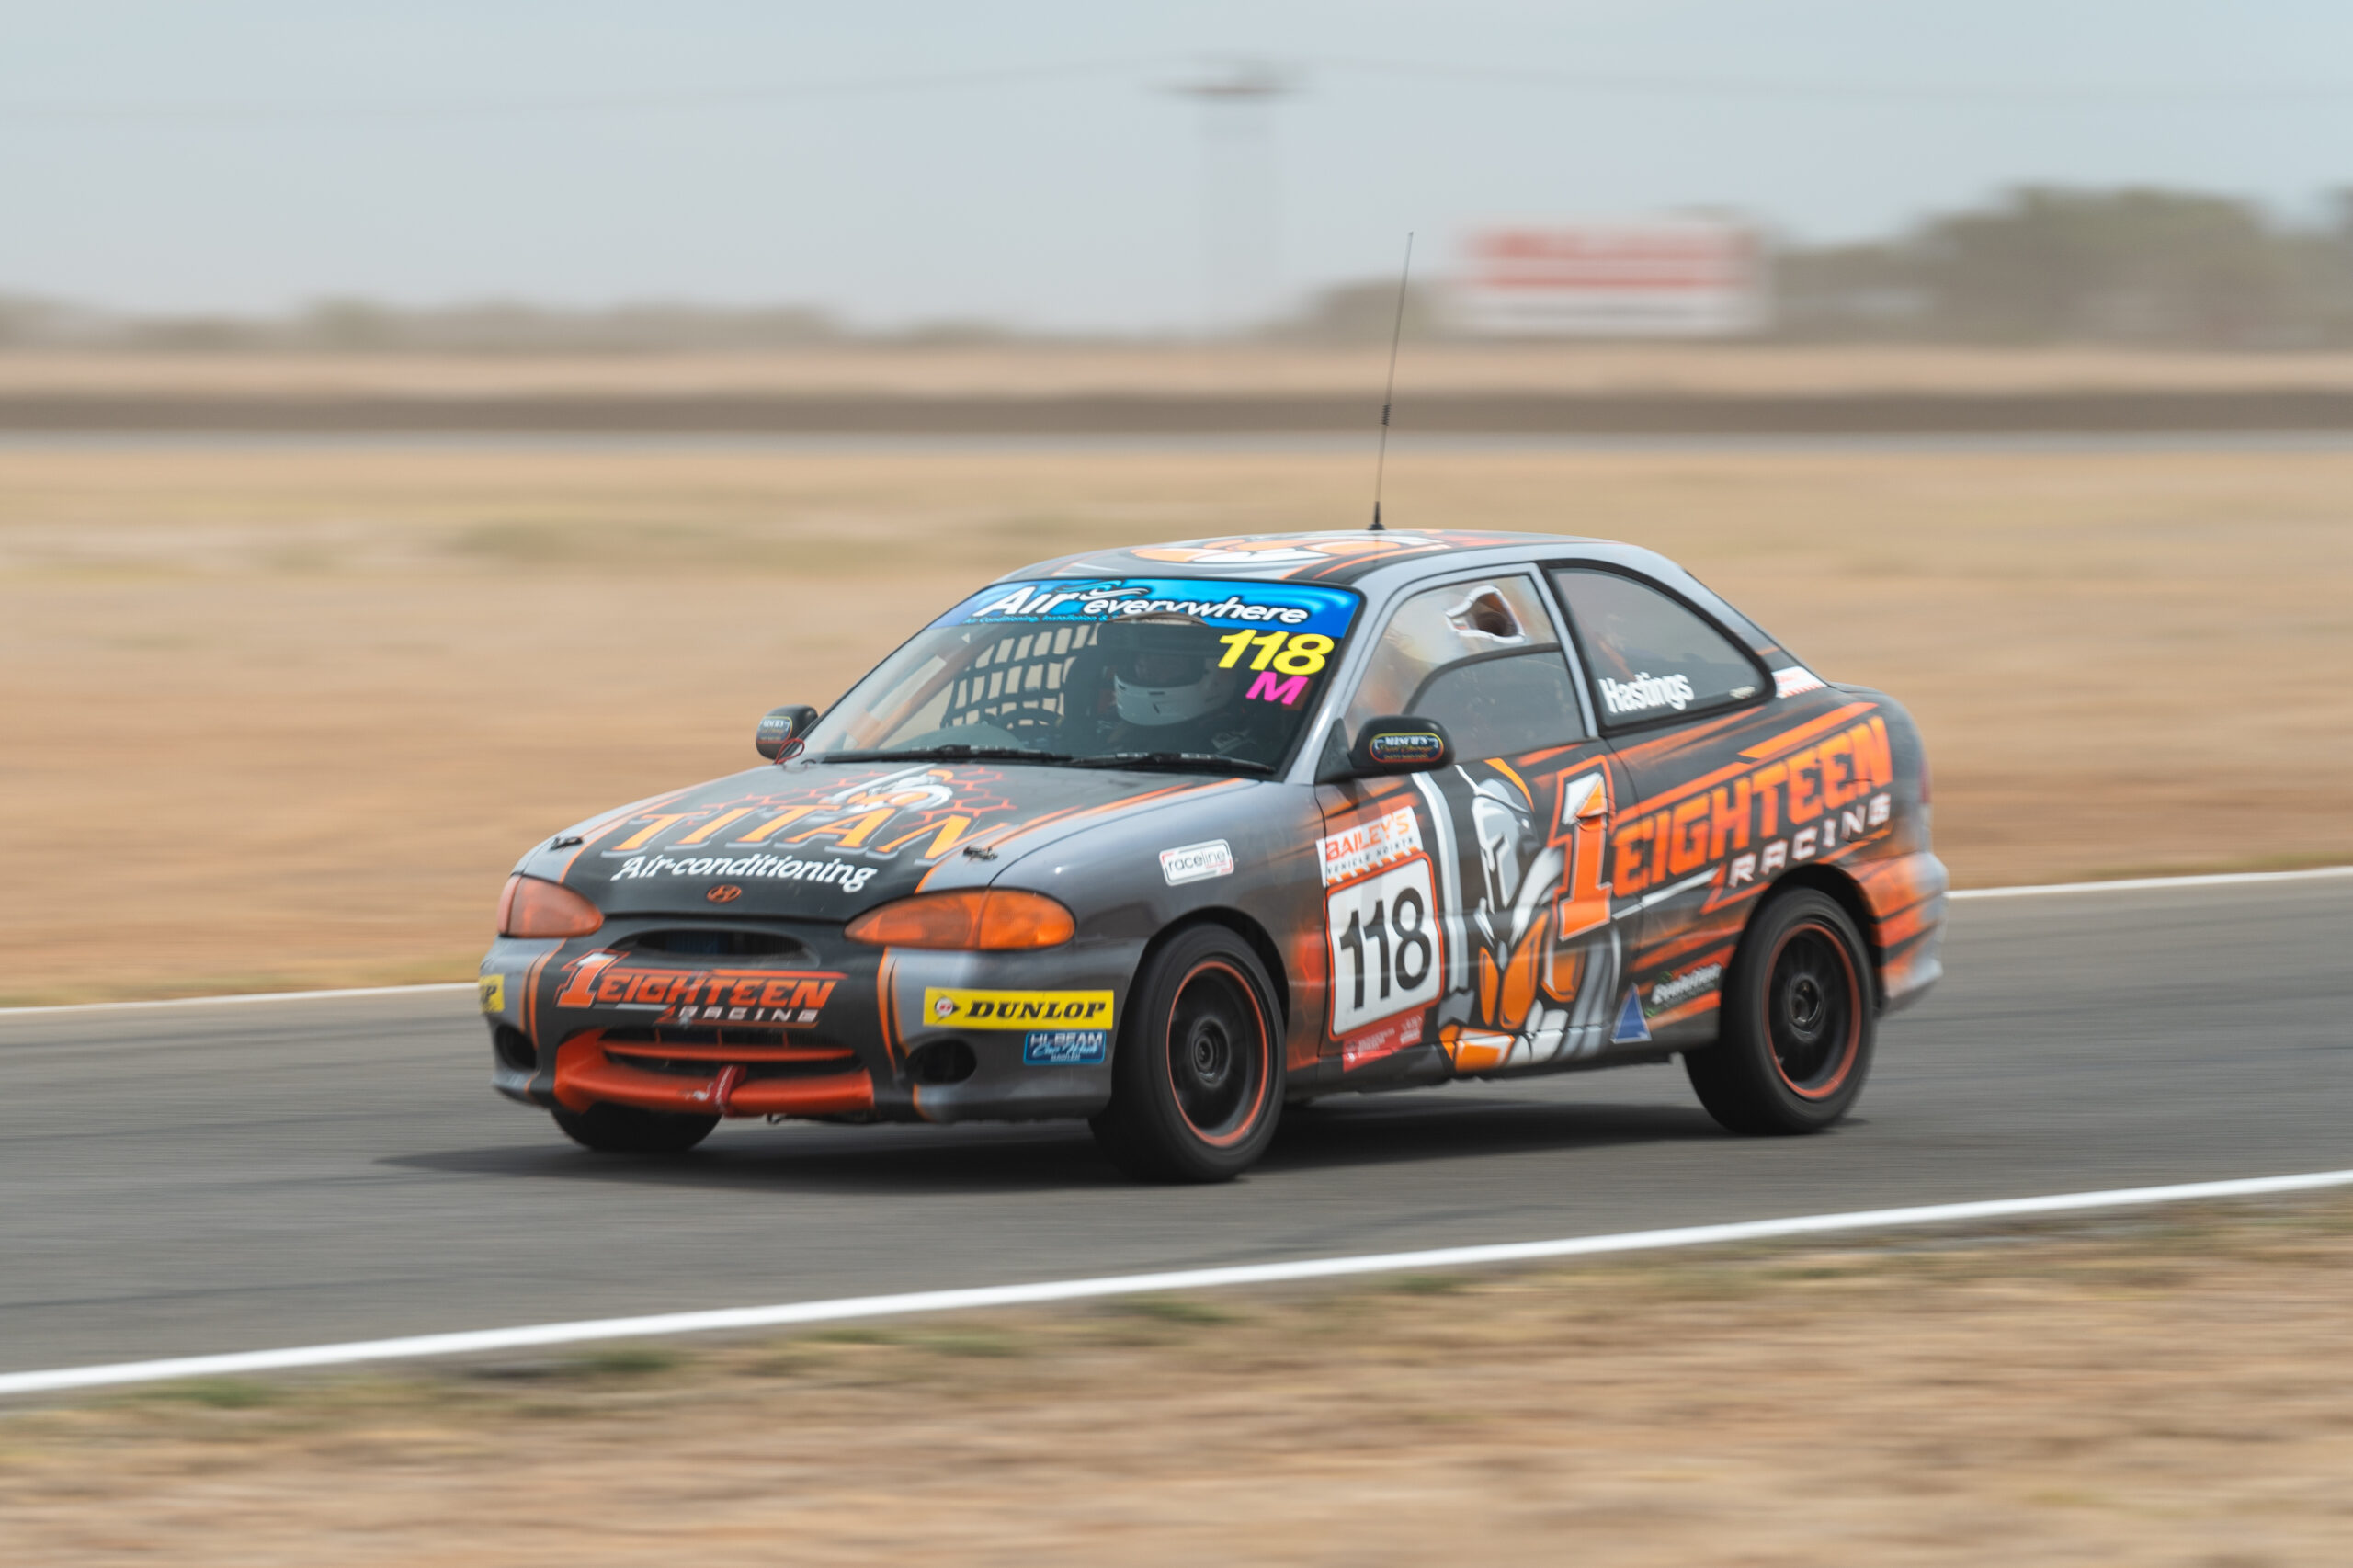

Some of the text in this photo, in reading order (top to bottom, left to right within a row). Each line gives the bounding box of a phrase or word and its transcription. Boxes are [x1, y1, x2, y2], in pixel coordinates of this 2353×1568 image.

[1083, 597, 1309, 624] everywhere
[1218, 629, 1335, 675] 118
[1245, 671, 1309, 706] M
[1598, 672, 1695, 713] Hastings
[607, 804, 1013, 862] TITAN
[1326, 812, 1410, 862] BAILEY'S
[1728, 792, 1891, 888] RACING
[1339, 887, 1431, 1010] 118
[678, 1006, 819, 1023] RACING
[964, 1000, 1106, 1020] DUNLOP
[1030, 1032, 1103, 1048] HI-BEAM
